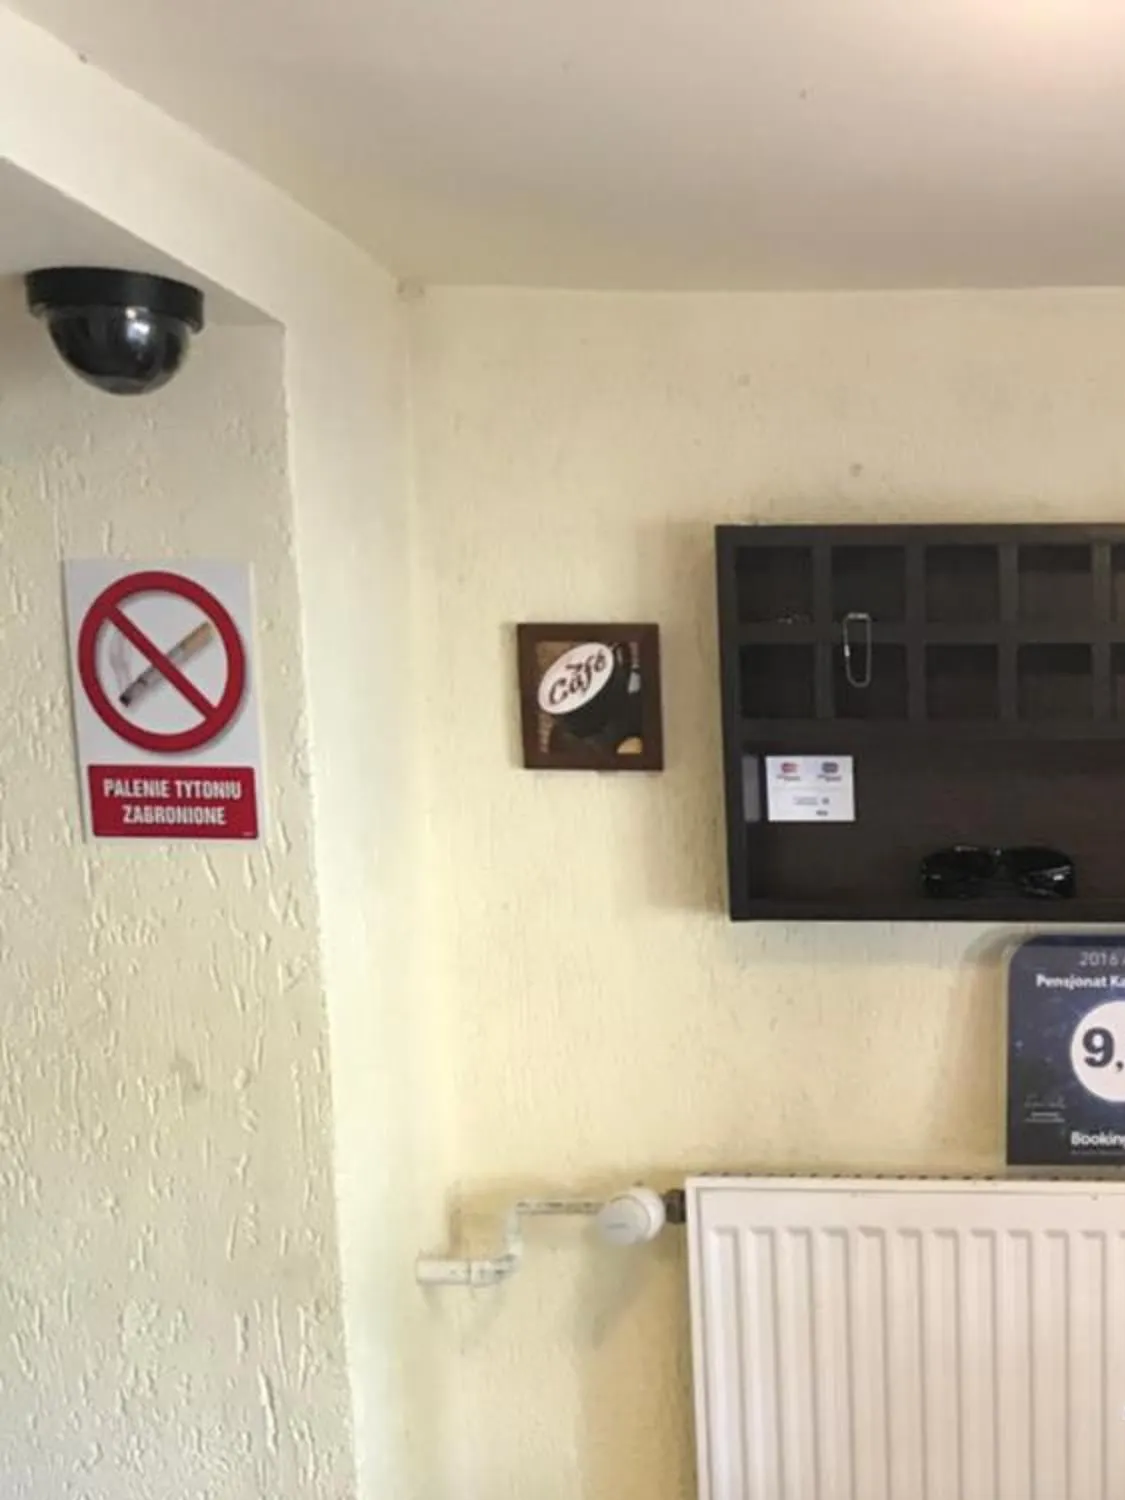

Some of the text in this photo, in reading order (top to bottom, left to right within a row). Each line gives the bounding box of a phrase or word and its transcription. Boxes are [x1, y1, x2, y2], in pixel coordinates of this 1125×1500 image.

[103, 778, 242, 799] PALENIE TYTONIU
[122, 804, 227, 825] ZABRONIONE
[1079, 951, 1119, 967] 2016
[1036, 973, 1107, 991] Pensjonat
